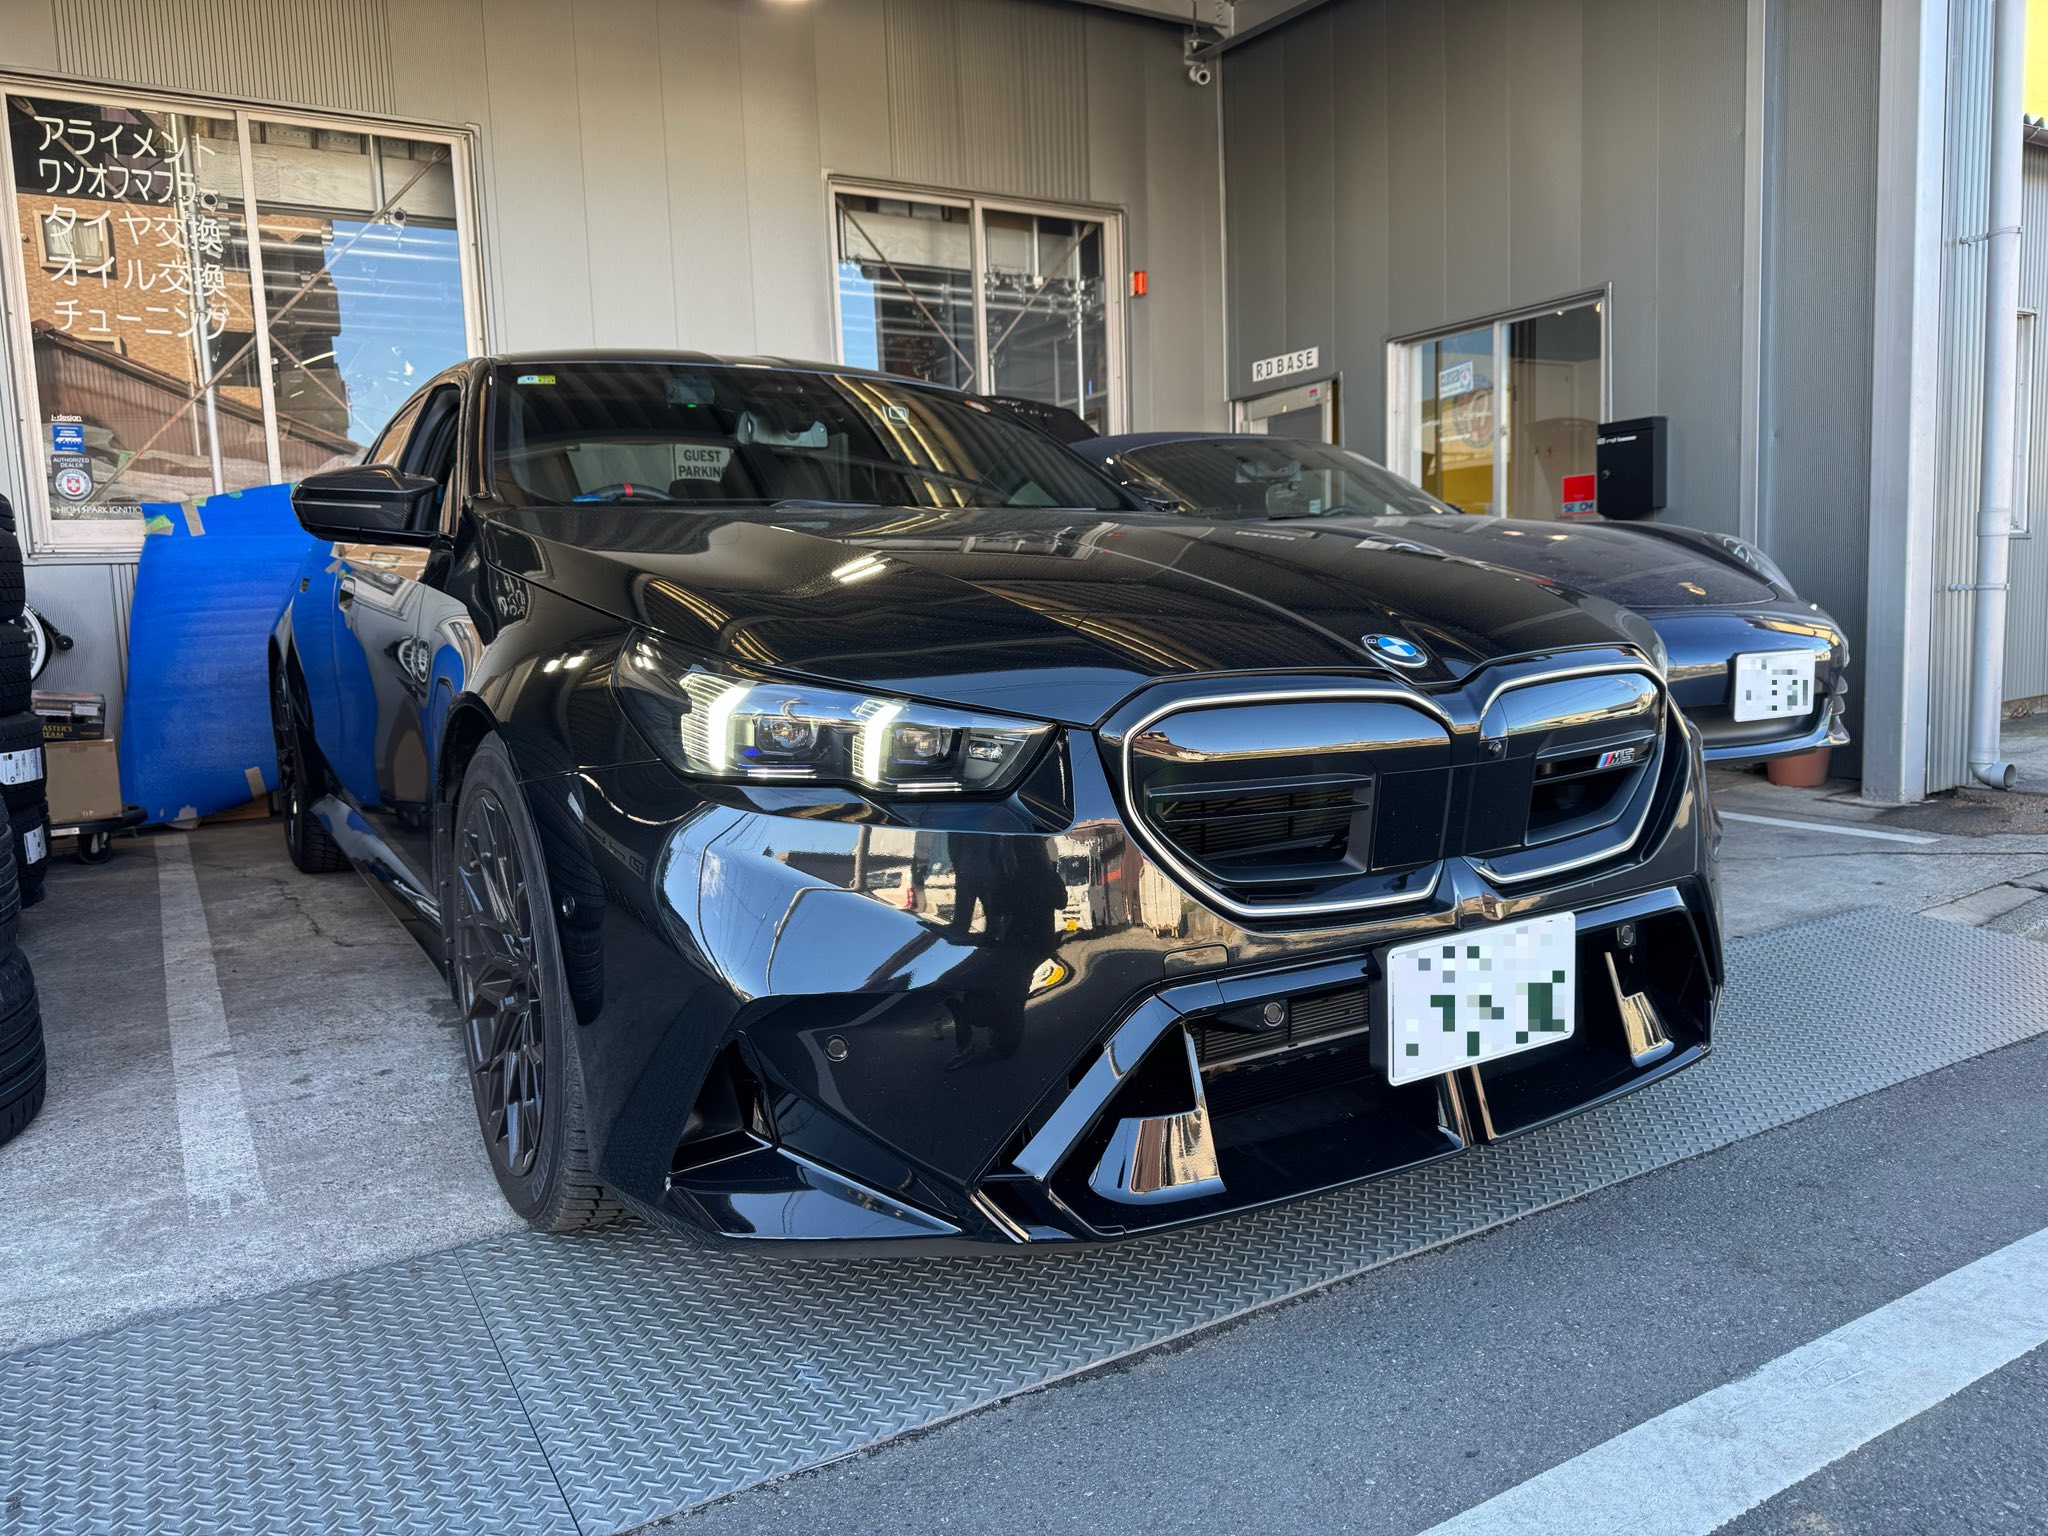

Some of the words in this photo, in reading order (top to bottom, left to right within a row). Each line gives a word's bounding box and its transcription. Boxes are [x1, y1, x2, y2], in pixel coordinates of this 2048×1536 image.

[33, 115, 217, 169] アライメント
[45, 203, 224, 258] タイヤ交換
[48, 256, 228, 299] オイル交換
[53, 298, 228, 340] チューニング
[683, 449, 721, 462] GUEST
[56, 506, 80, 514] HIGH
[81, 505, 108, 514] SPARK
[109, 506, 143, 514] IGNITIO
[42, 725, 72, 733] ASTER'S
